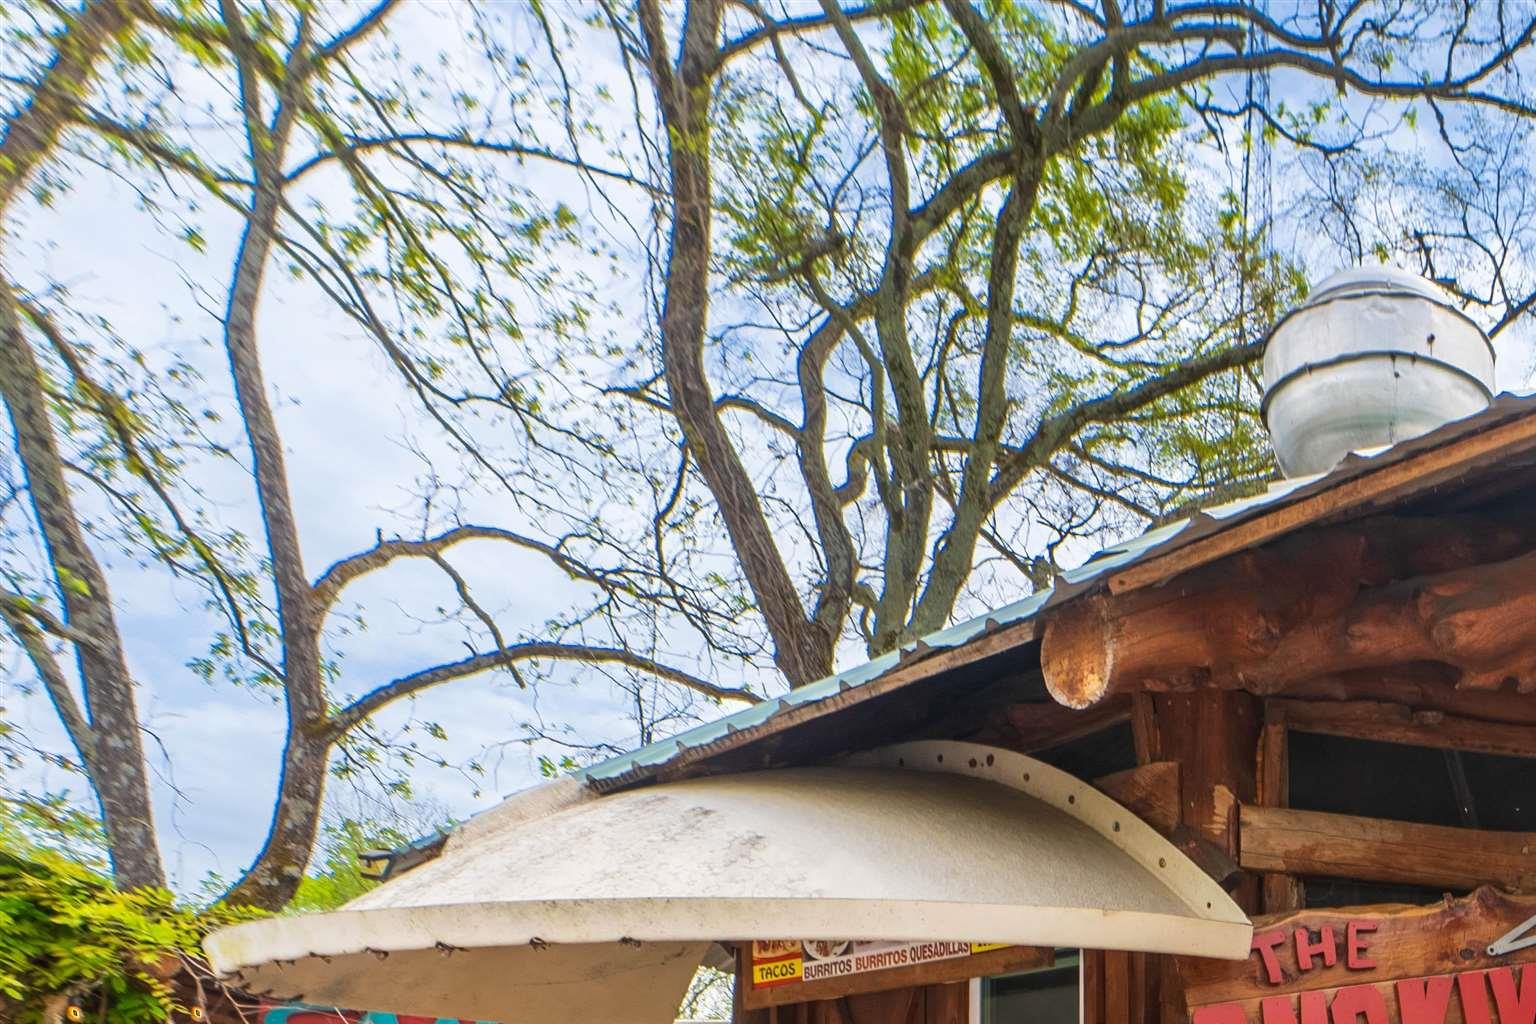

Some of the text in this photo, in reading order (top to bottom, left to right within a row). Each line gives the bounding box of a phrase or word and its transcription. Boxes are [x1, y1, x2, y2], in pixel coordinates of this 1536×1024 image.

[759, 941, 969, 980] TACOS BURRITOS BURRITOS QUESADILLAS
[1252, 921, 1378, 985] THE
